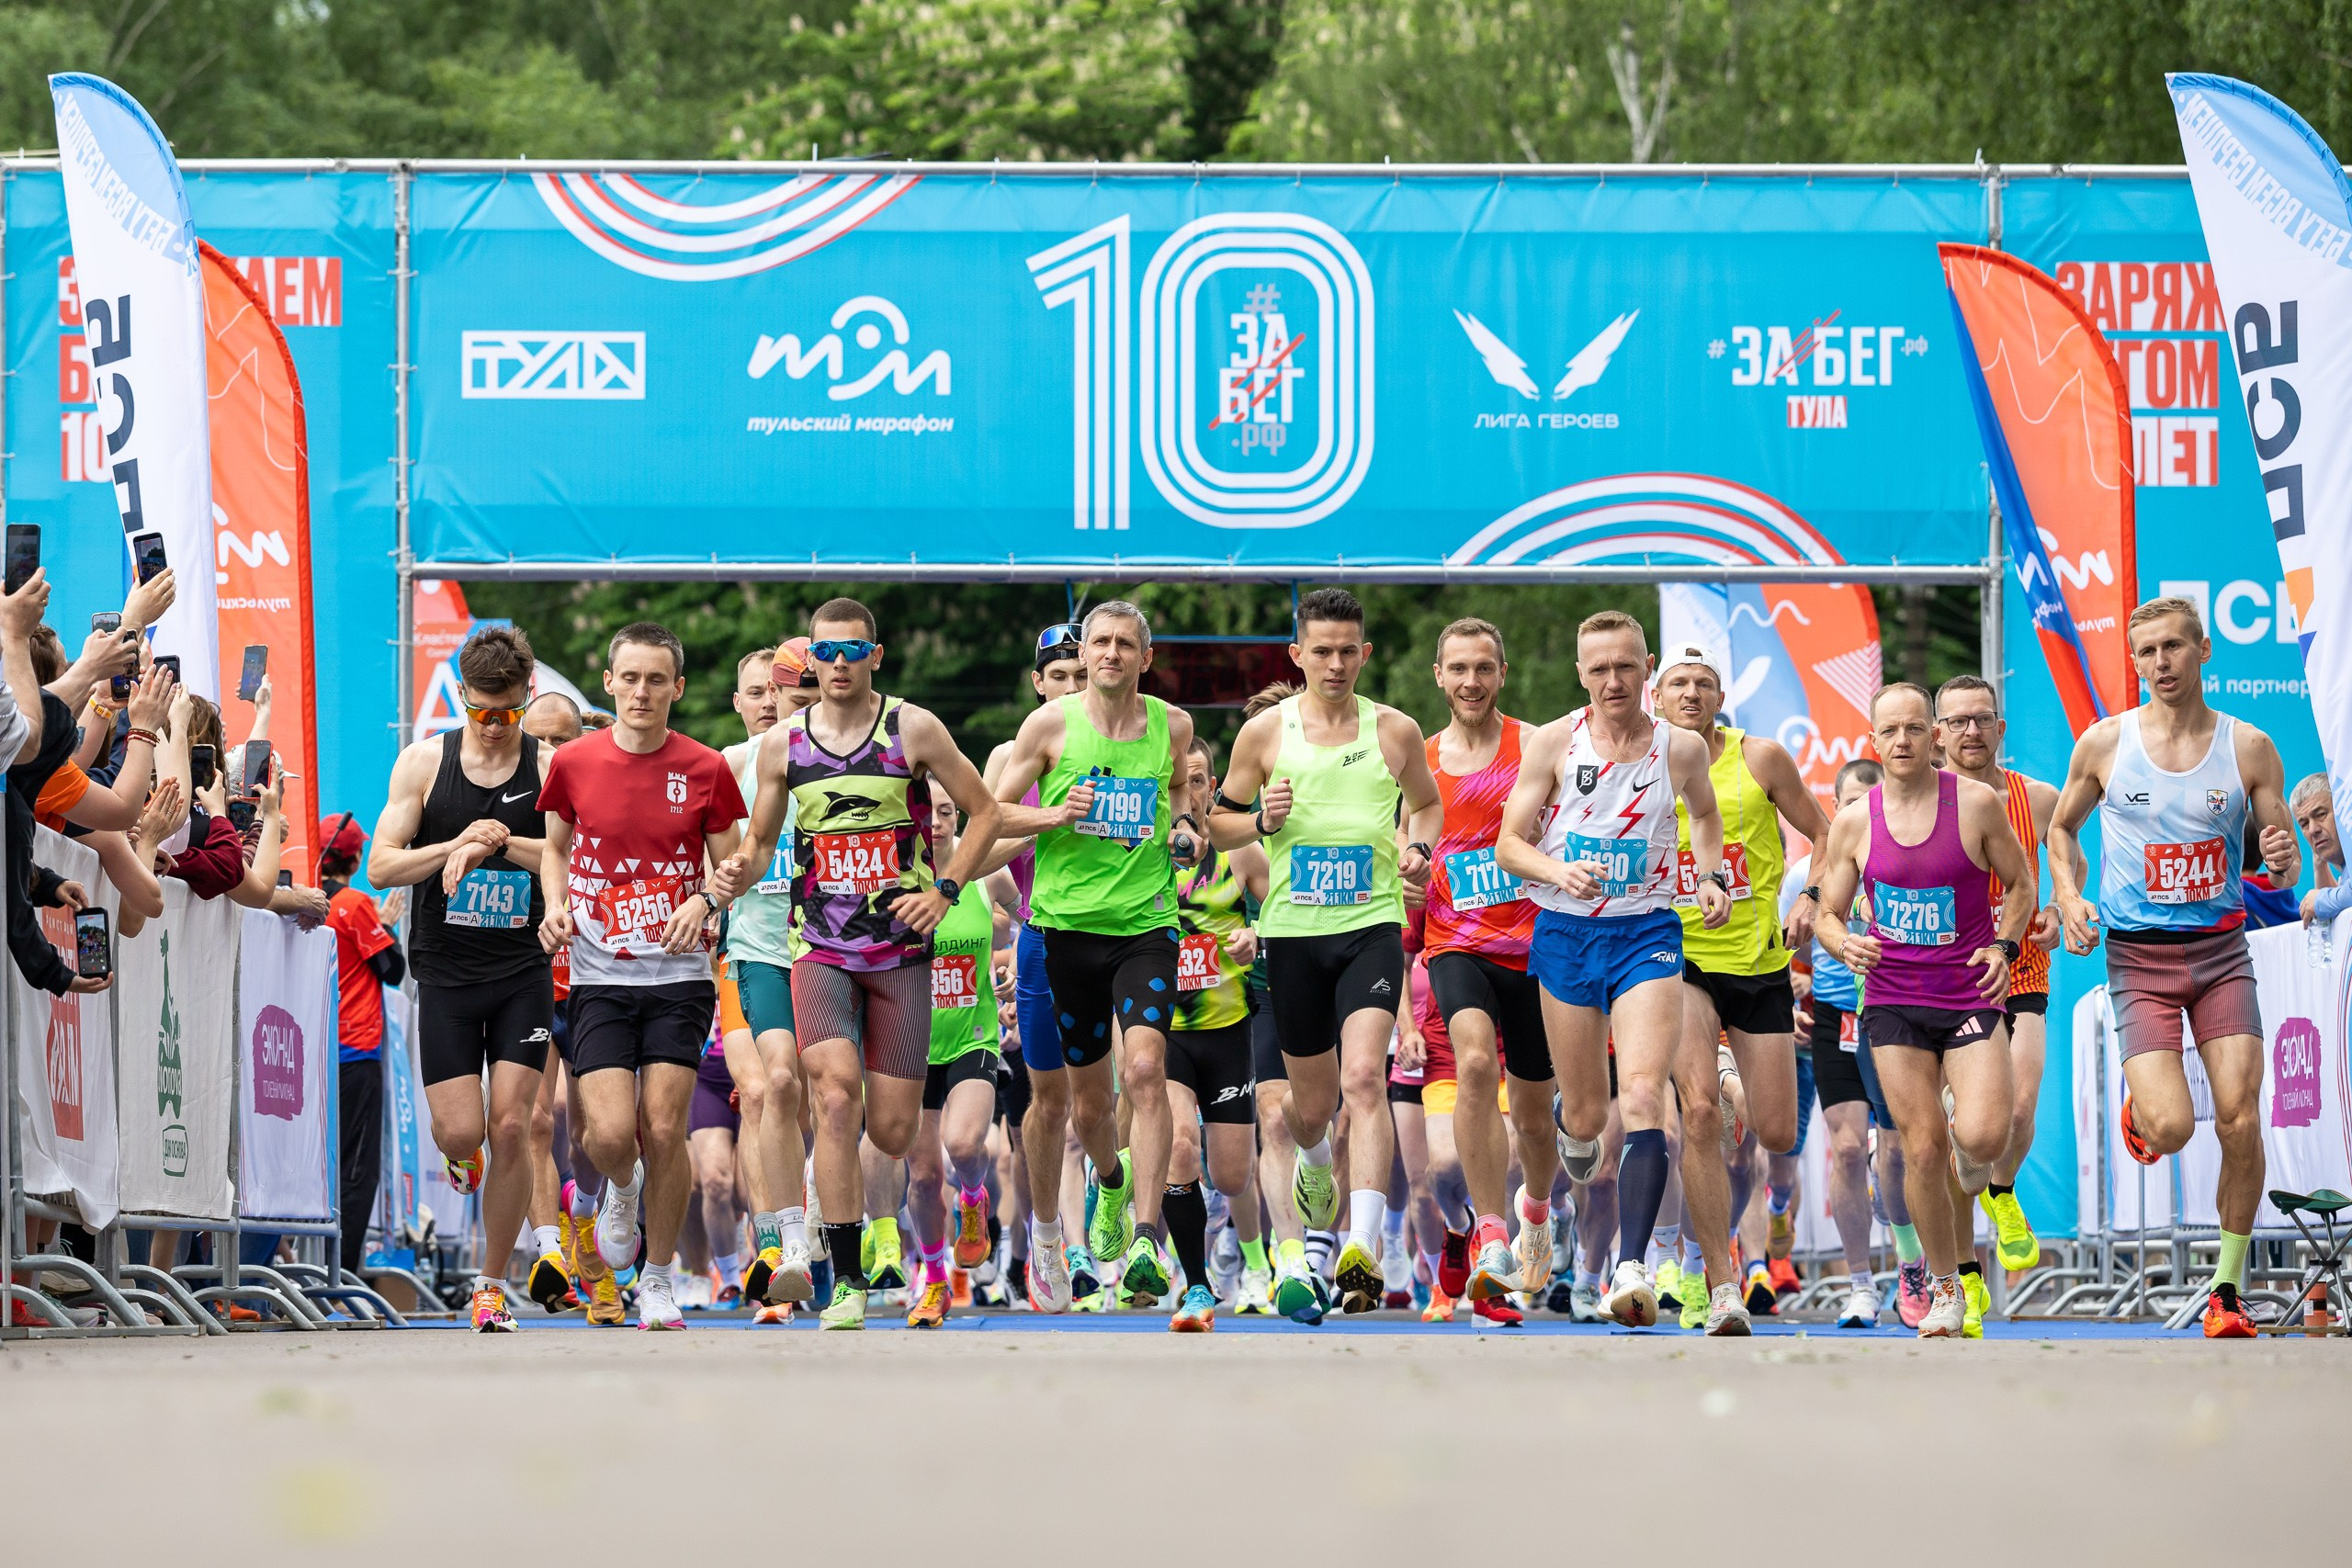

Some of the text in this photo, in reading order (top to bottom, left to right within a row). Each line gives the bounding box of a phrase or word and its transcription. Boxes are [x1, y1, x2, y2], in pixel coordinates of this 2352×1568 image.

[1025, 213, 1375, 531] 10
[747, 412, 955, 435] тульский марафон
[1474, 412, 1620, 429] ЛИГА ГЕРОЕВ
[1787, 396, 1848, 429] ТУЛА
[1094, 792, 1141, 822] 7199
[828, 847, 885, 879] 5424
[1307, 861, 1356, 889] 7219
[2159, 854, 2215, 888] 5244
[466, 882, 514, 913] 7143
[615, 891, 673, 931] 5256
[1887, 899, 1939, 931] 7276
